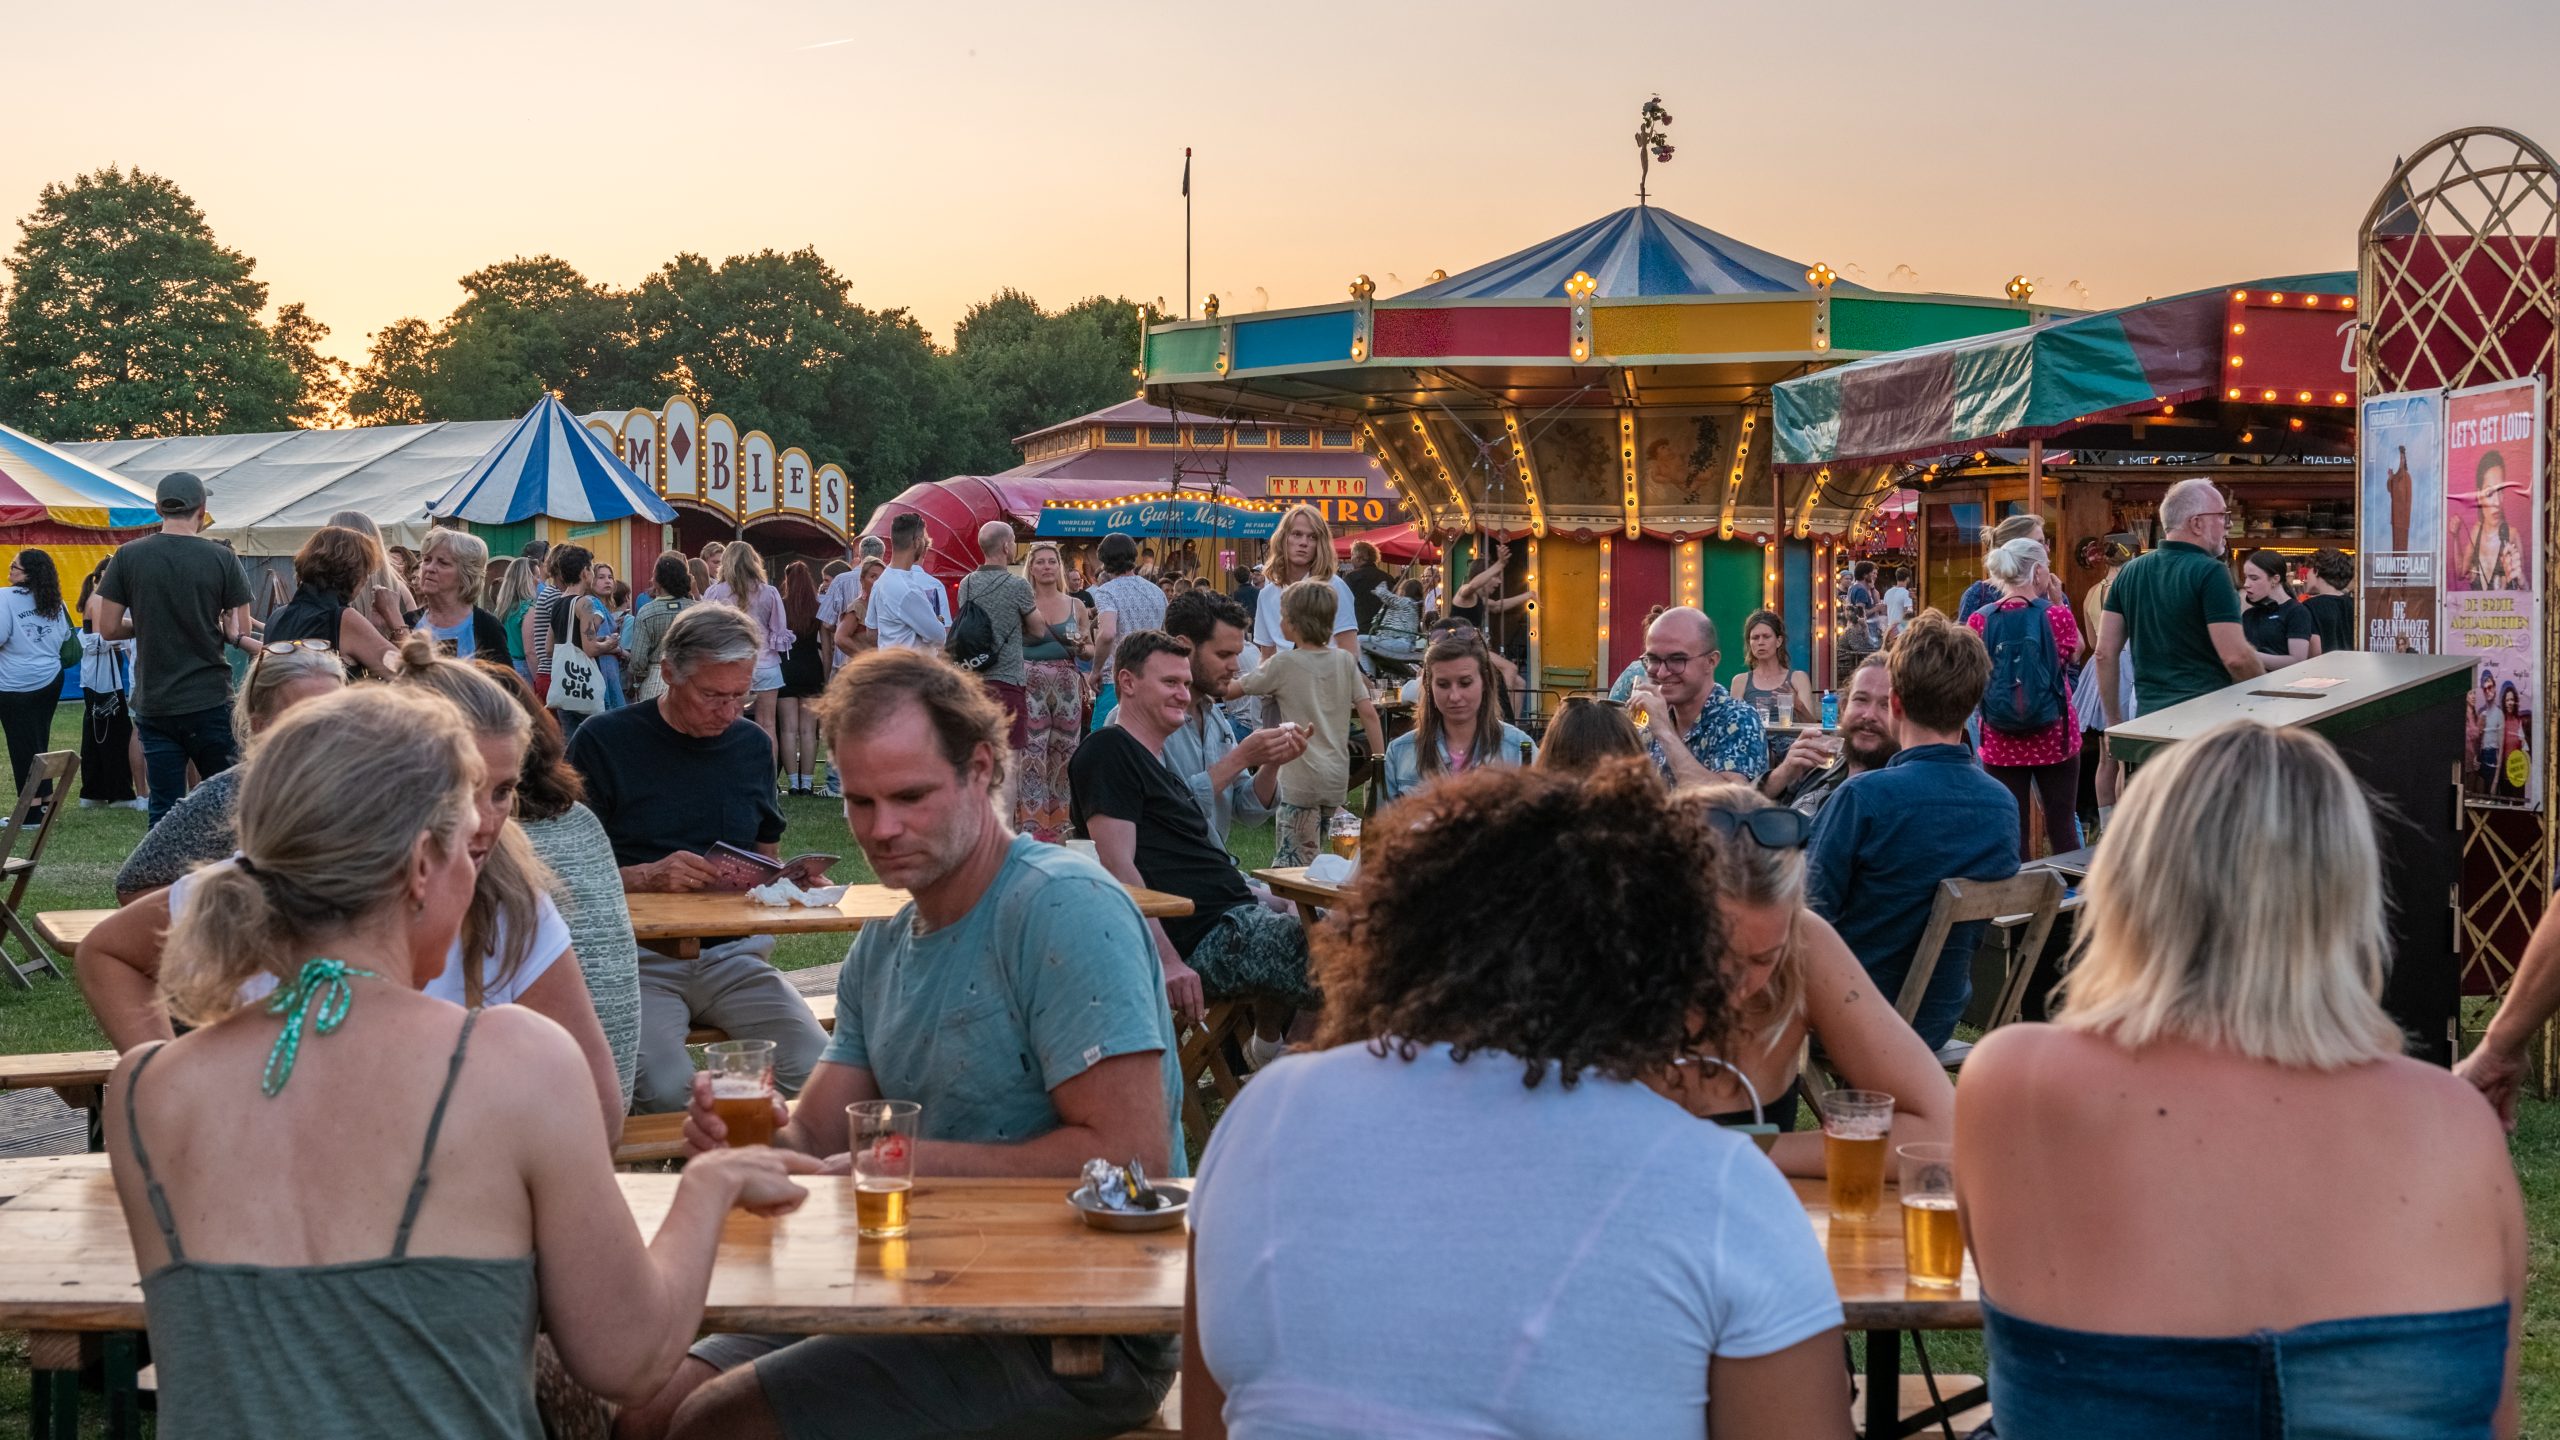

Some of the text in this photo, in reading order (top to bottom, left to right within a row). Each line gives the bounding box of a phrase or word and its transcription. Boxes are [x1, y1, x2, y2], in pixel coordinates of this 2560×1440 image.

[2451, 411, 2530, 448] LET'S GET LOUD
[2129, 455, 2186, 466] MEROT
[1273, 479, 1364, 494] TEATRO
[1107, 510, 1134, 529] Au
[1187, 506, 1236, 529] Marie
[2375, 556, 2429, 573] RUIMTEPLAAT
[2392, 601, 2406, 619] DE
[2464, 598, 2478, 611] DE
[2370, 618, 2429, 637] GRANDIOZE
[2409, 637, 2429, 655] VAN
